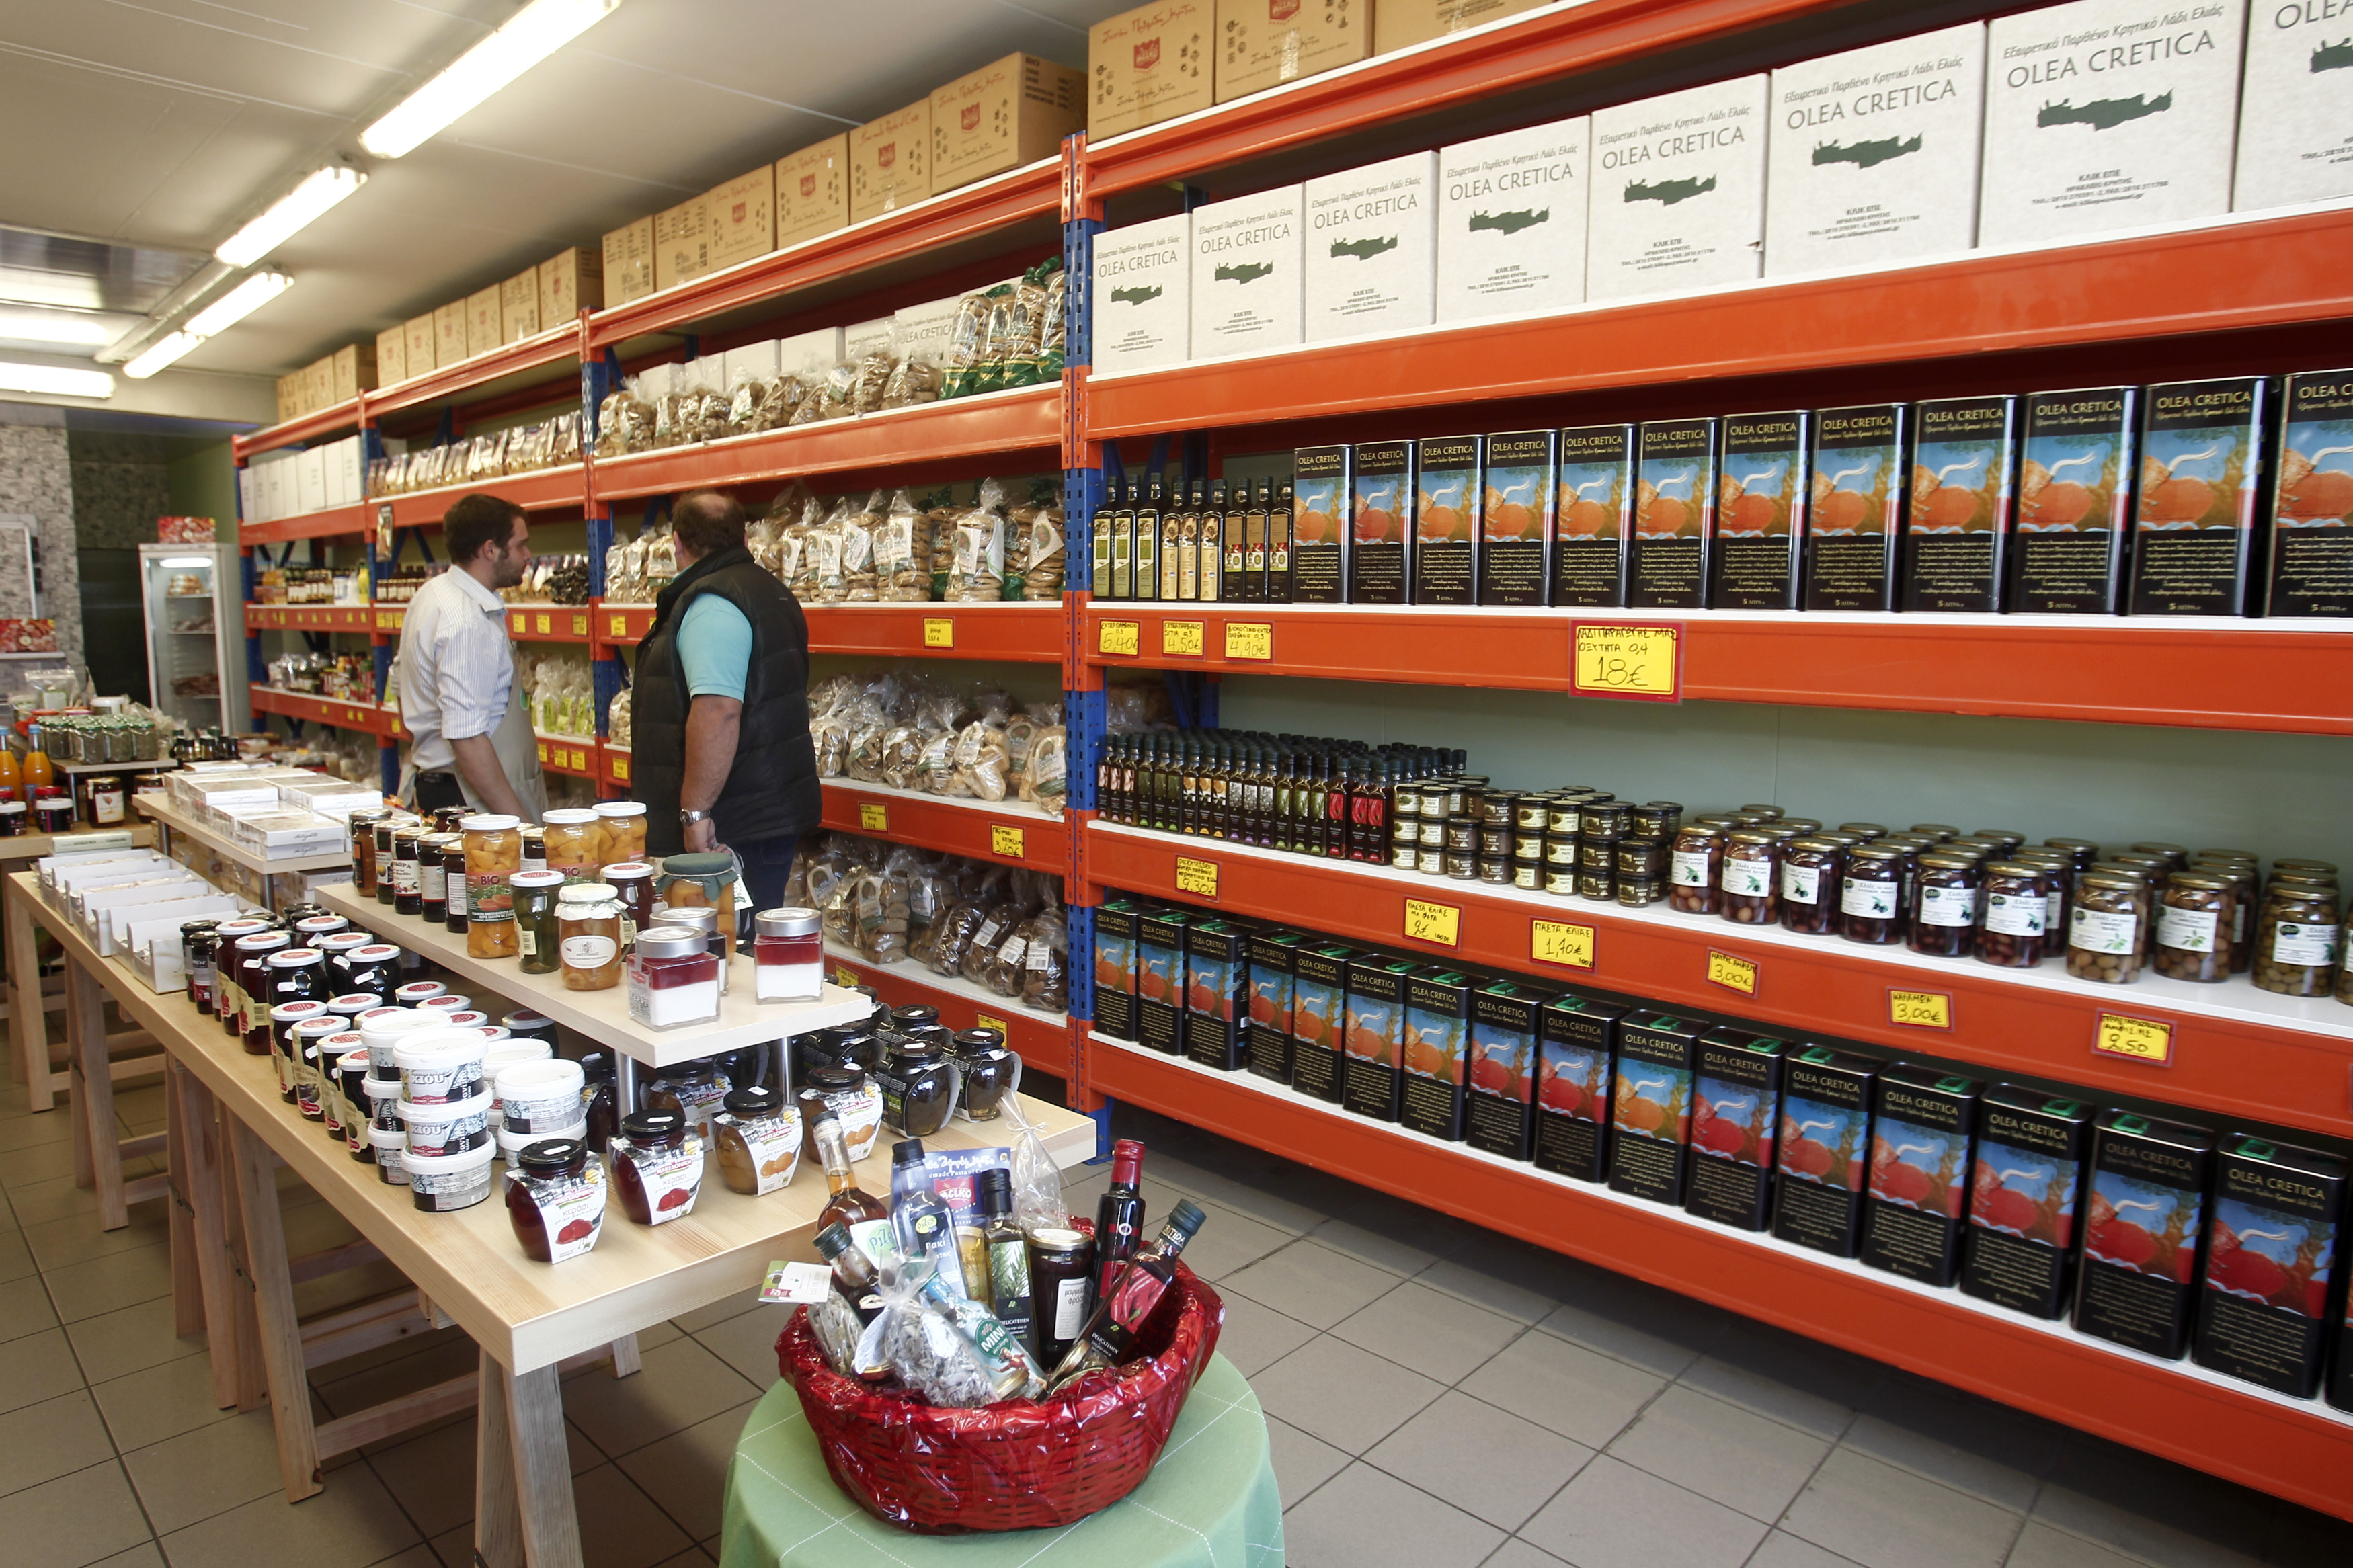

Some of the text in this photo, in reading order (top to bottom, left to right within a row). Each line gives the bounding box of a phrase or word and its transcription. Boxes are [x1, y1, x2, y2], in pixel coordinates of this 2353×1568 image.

[2007, 27, 2215, 88] OLEA CRETICA
[1788, 77, 1956, 129] OLEA CRETICA
[1603, 124, 1745, 169] OLEA CRETICA
[1450, 163, 1573, 200] OLEA CRETICA
[1315, 191, 1417, 229] OLEA CRETICA
[1201, 224, 1290, 254] OLEA CRETICA
[1099, 250, 1177, 278] OLEA CRETICA
[2157, 392, 2251, 408] OLEA CRETICA
[2299, 386, 2337, 398] OLEA
[1926, 409, 2003, 422] OLEA CRETICA
[2036, 401, 2122, 415] OLEA CRETICA
[1730, 423, 1796, 435] OLEA CRETICA
[1823, 417, 1892, 429] OLEA CRETICA
[1566, 436, 1622, 447] OLEA CRETICA
[1646, 430, 1706, 442] OLEA CRETICA
[1424, 446, 1473, 456] OLEA CRETICA
[1492, 441, 1546, 451] OLEA CRETICA
[1316, 455, 1341, 463] CRETICA
[1378, 450, 1404, 459] CRETICA
[1230, 641, 1267, 657] 4,90€
[1579, 642, 1648, 655] ΟΞΥΤΗΤΑ 0,4
[1593, 657, 1648, 686] 18€
[561, 867, 580, 876] BIO
[481, 875, 500, 886] BIO
[1408, 903, 1426, 914] ΠΑΣΤΑ
[1111, 919, 1129, 927] CRETICA
[1535, 922, 1590, 938] ΠΑΣΤΑ ΕΛΙΑΣ
[1156, 928, 1174, 938] CRETICA
[1207, 940, 1226, 950] CRETICA
[1299, 959, 1337, 973] OLEA CRETICA
[1352, 973, 1395, 989] OLEA CRETICA
[1412, 987, 1457, 1003] OLEA CRETICA
[1478, 1001, 1527, 1018] OLEA CRETICA
[1897, 1003, 1943, 1023] 3,00€
[1548, 1018, 1602, 1036] OLEA CRETICA
[1626, 1034, 1684, 1053] OLEA CRETICA
[1705, 1053, 1767, 1073] OLEA CRETICA
[1794, 1071, 1860, 1093] OLEA CRETICA
[1886, 1092, 1958, 1116] OLEA CRETICA
[760, 1127, 792, 1143] ΜΑΚΕΔΟΝΙΚΗ
[1990, 1114, 2068, 1141] OLEA CRETICA
[657, 1159, 692, 1175] ΜΑΚΕΔΟΝΙΚΗ
[2229, 1169, 2325, 1200] OLEA CRETICA
[555, 1188, 594, 1205] ΜΑΚΕΔΟΝΙΚΗ
[980, 1325, 1006, 1352] MINI
[1092, 1332, 1119, 1354] DELICATESSEN
